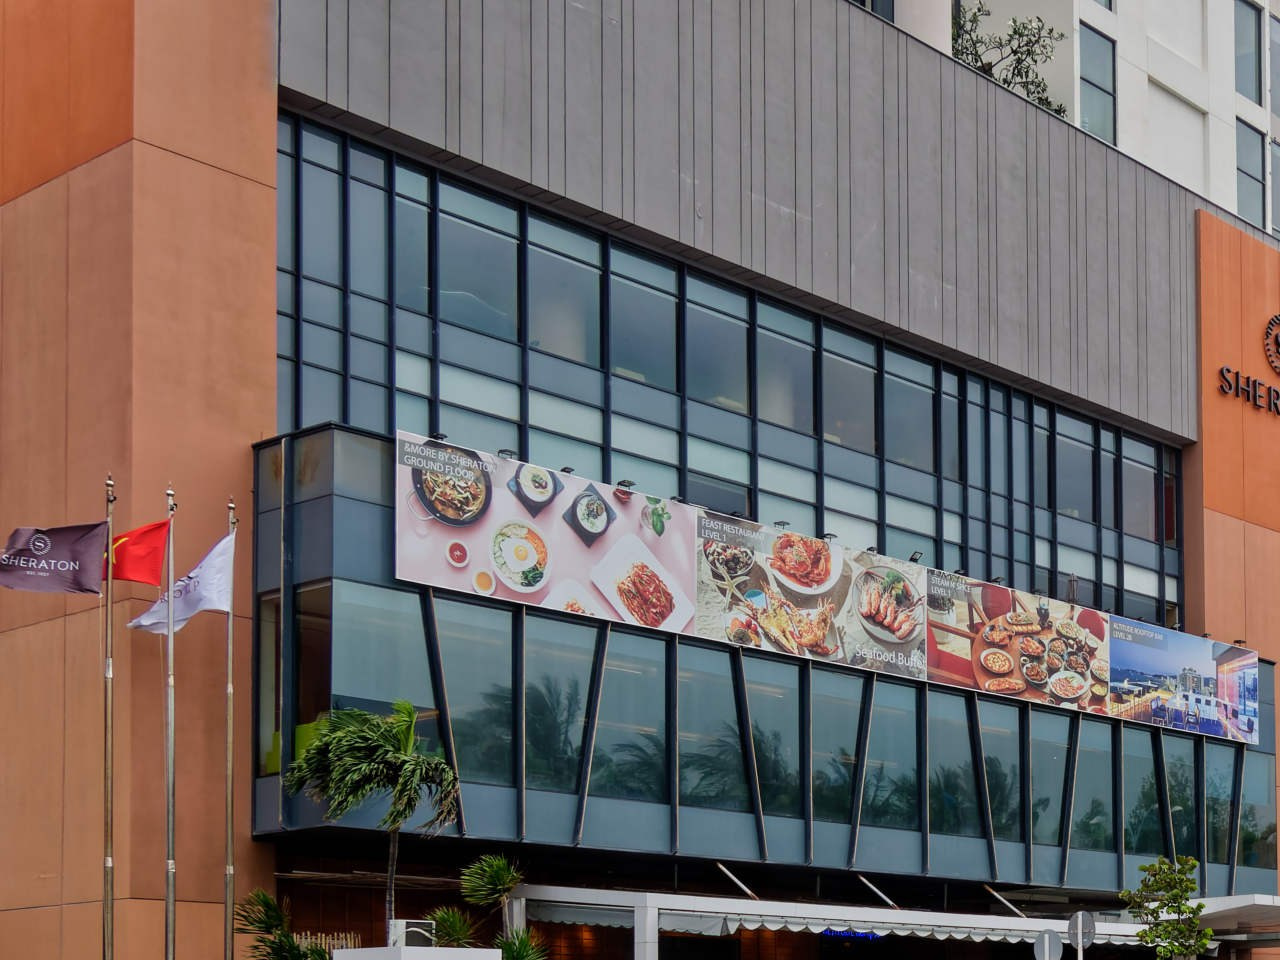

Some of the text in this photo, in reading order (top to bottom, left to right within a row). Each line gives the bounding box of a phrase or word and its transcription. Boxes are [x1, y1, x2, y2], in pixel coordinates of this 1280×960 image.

[404, 443, 496, 473] &MORE BY SHERATON
[403, 455, 474, 481] GROUND FLOOR
[702, 519, 722, 530] FEAST
[701, 529, 721, 541] LEVEL
[1, 554, 80, 571] SHERATON
[931, 577, 949, 588] STEAM
[931, 586, 947, 596] LEVEL
[855, 644, 895, 663] Seafood
